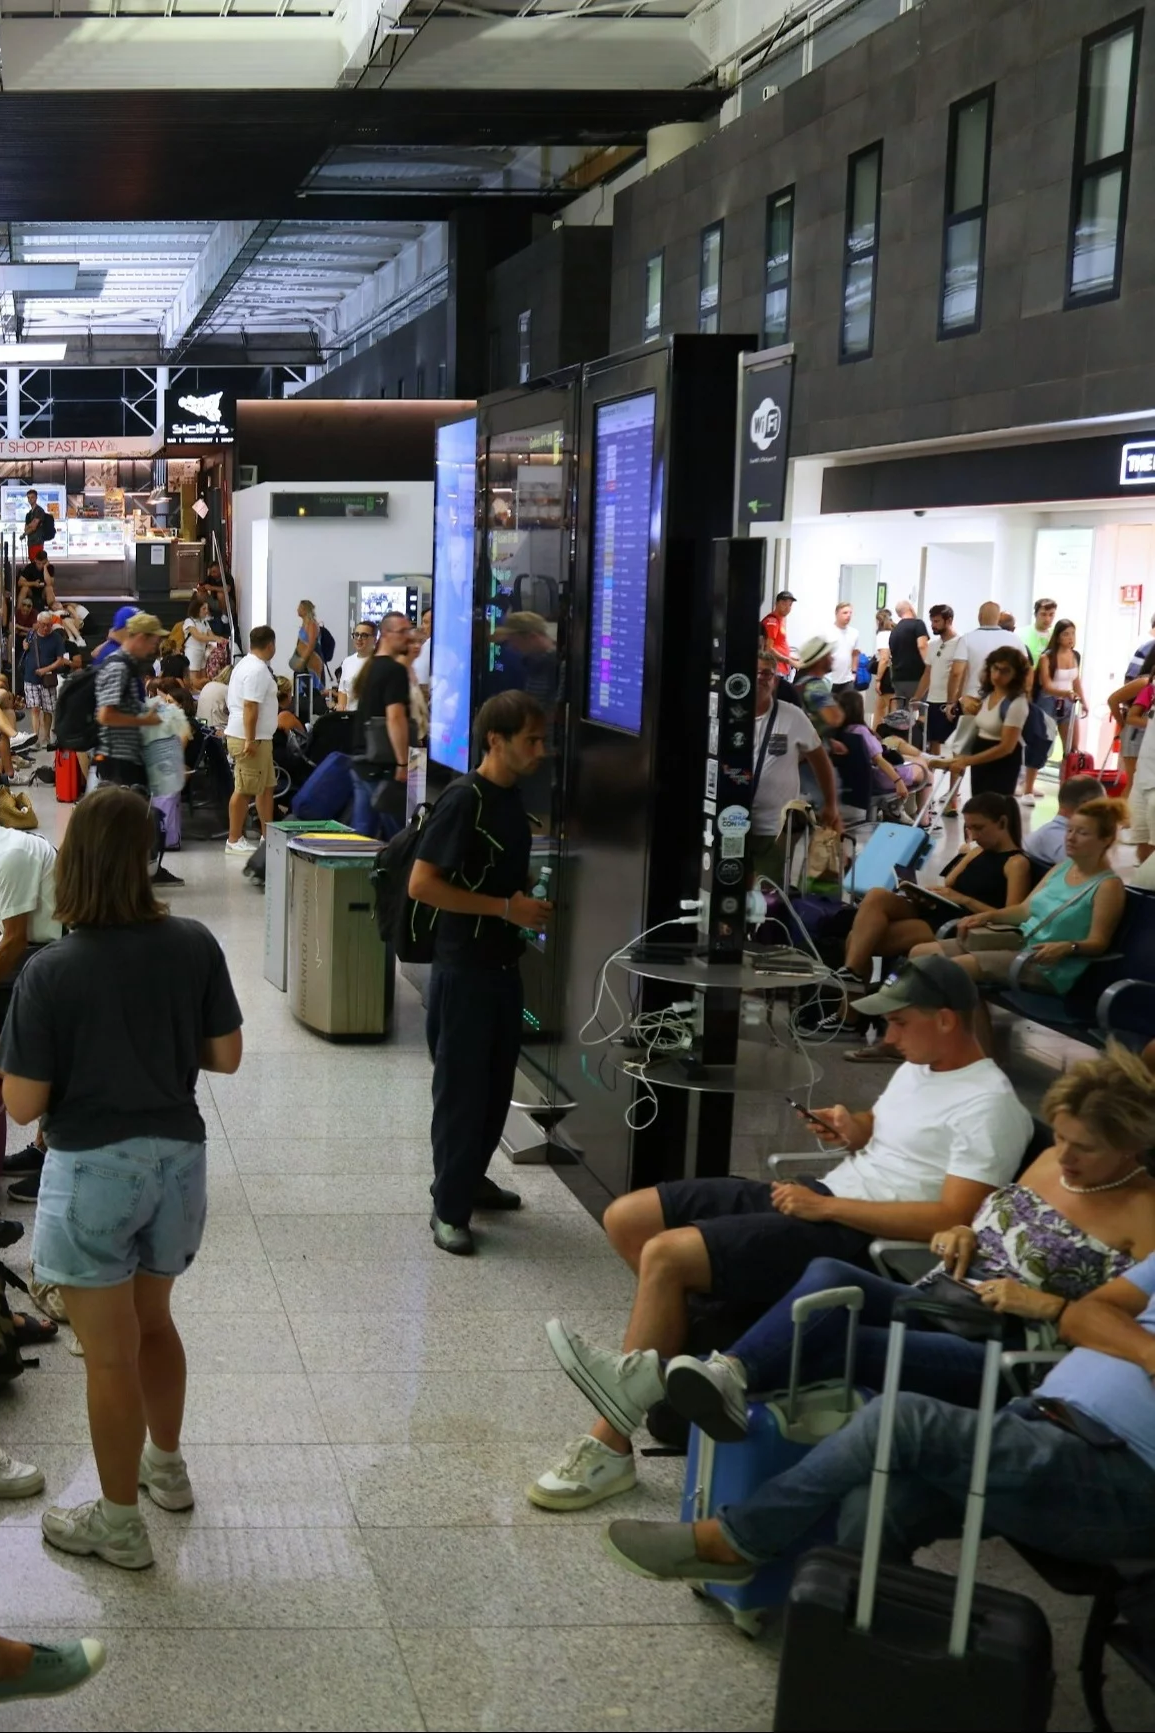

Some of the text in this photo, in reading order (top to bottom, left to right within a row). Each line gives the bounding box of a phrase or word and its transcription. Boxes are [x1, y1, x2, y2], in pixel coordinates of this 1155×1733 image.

[8, 440, 45, 454] SHOP
[48, 440, 77, 453] FAST
[81, 439, 105, 452] PAY
[300, 943, 308, 1018] ORGANICO
